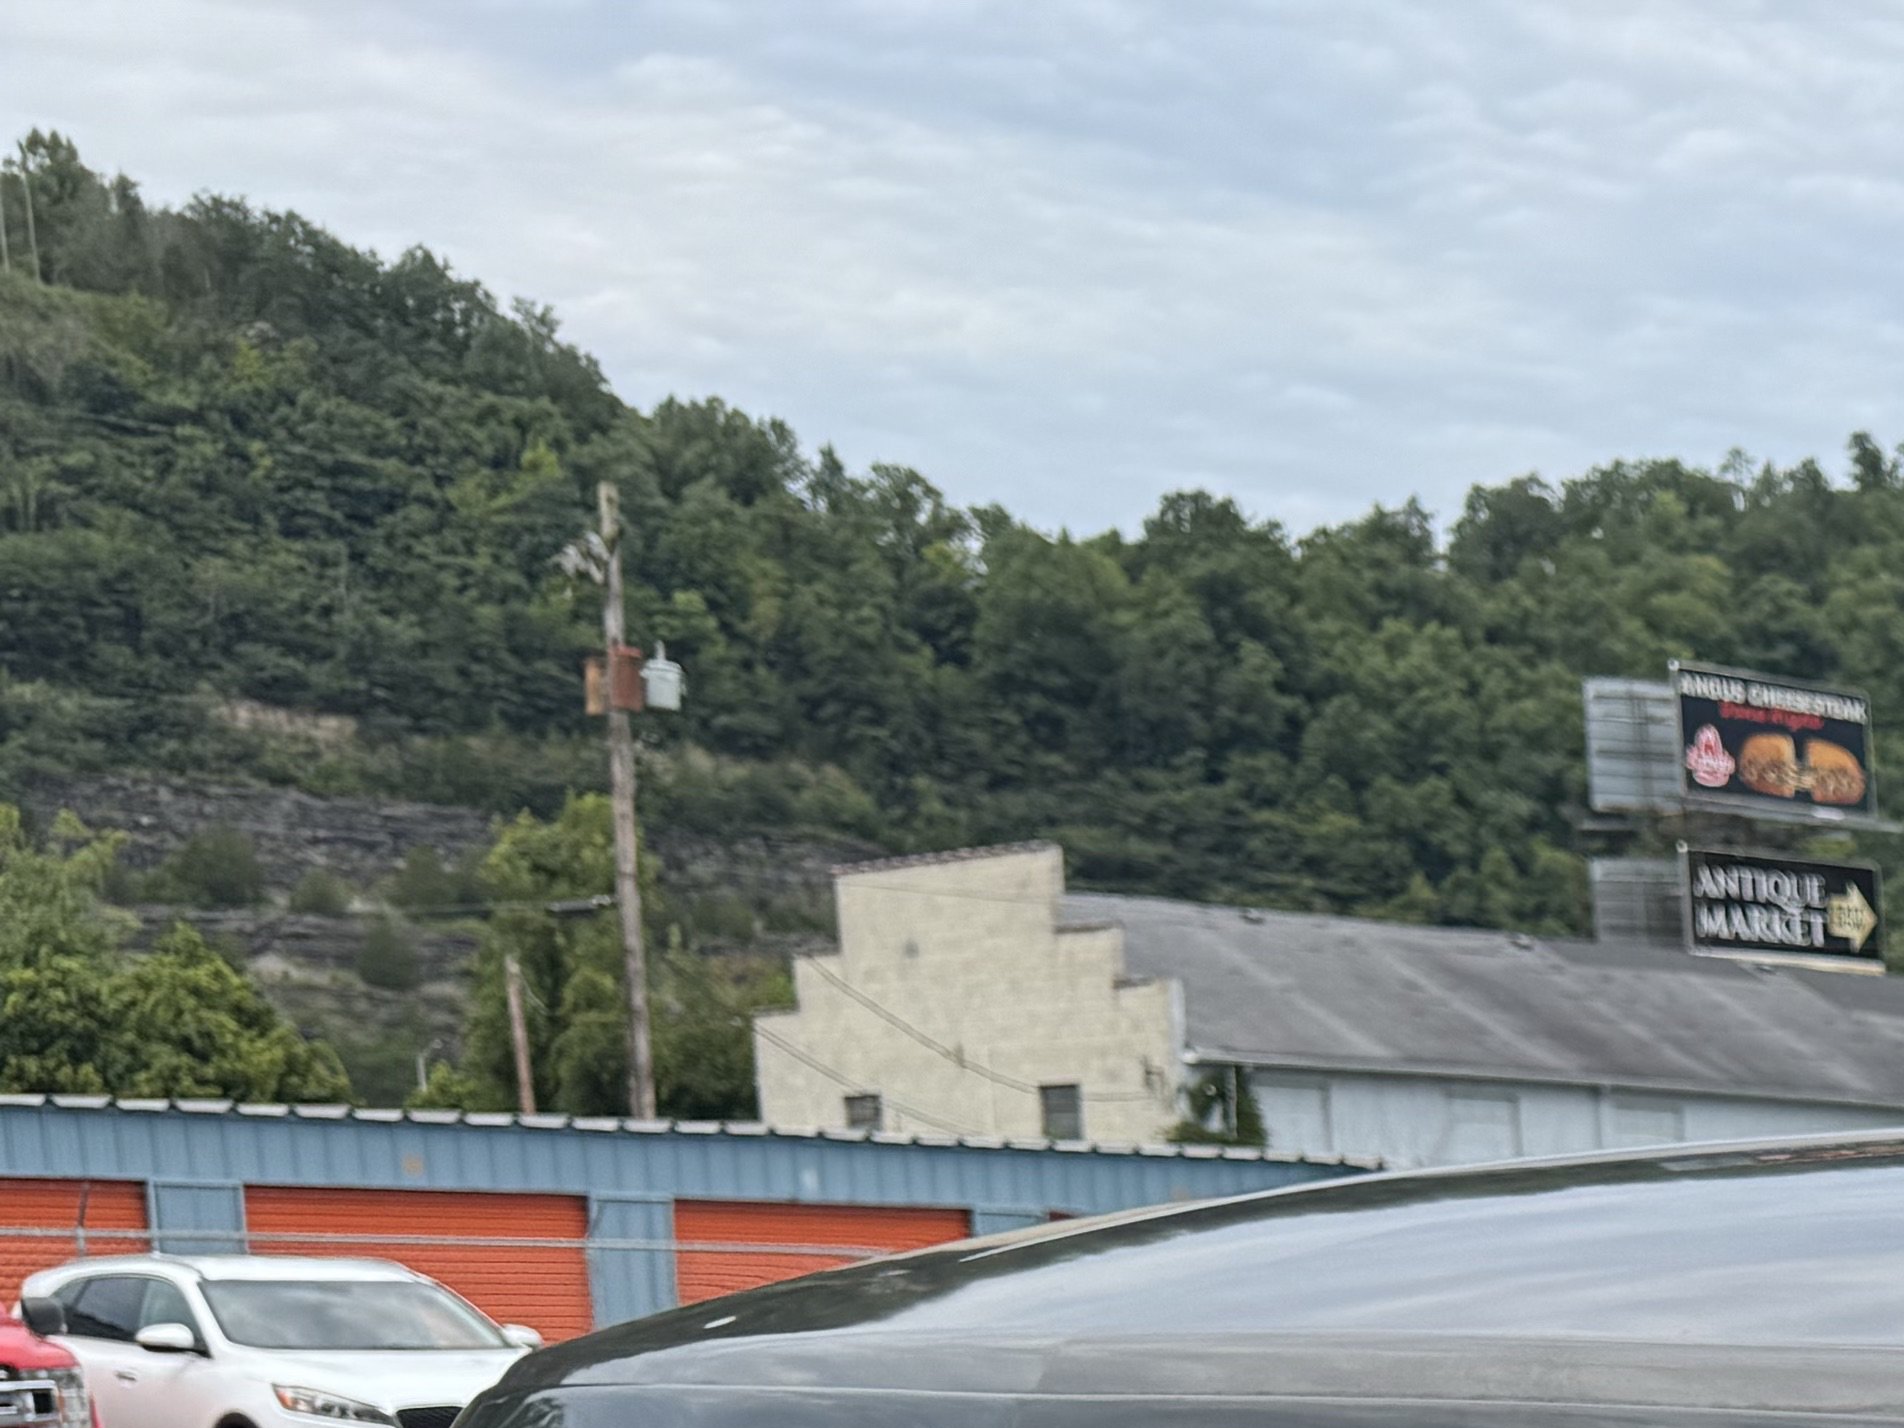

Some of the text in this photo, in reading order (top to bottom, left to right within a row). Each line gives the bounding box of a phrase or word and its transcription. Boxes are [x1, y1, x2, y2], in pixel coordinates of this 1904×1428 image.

[1679, 671, 1747, 705] ANGUS
[1692, 863, 1828, 912] ANTIQUE
[1694, 901, 1830, 948] MARKET
